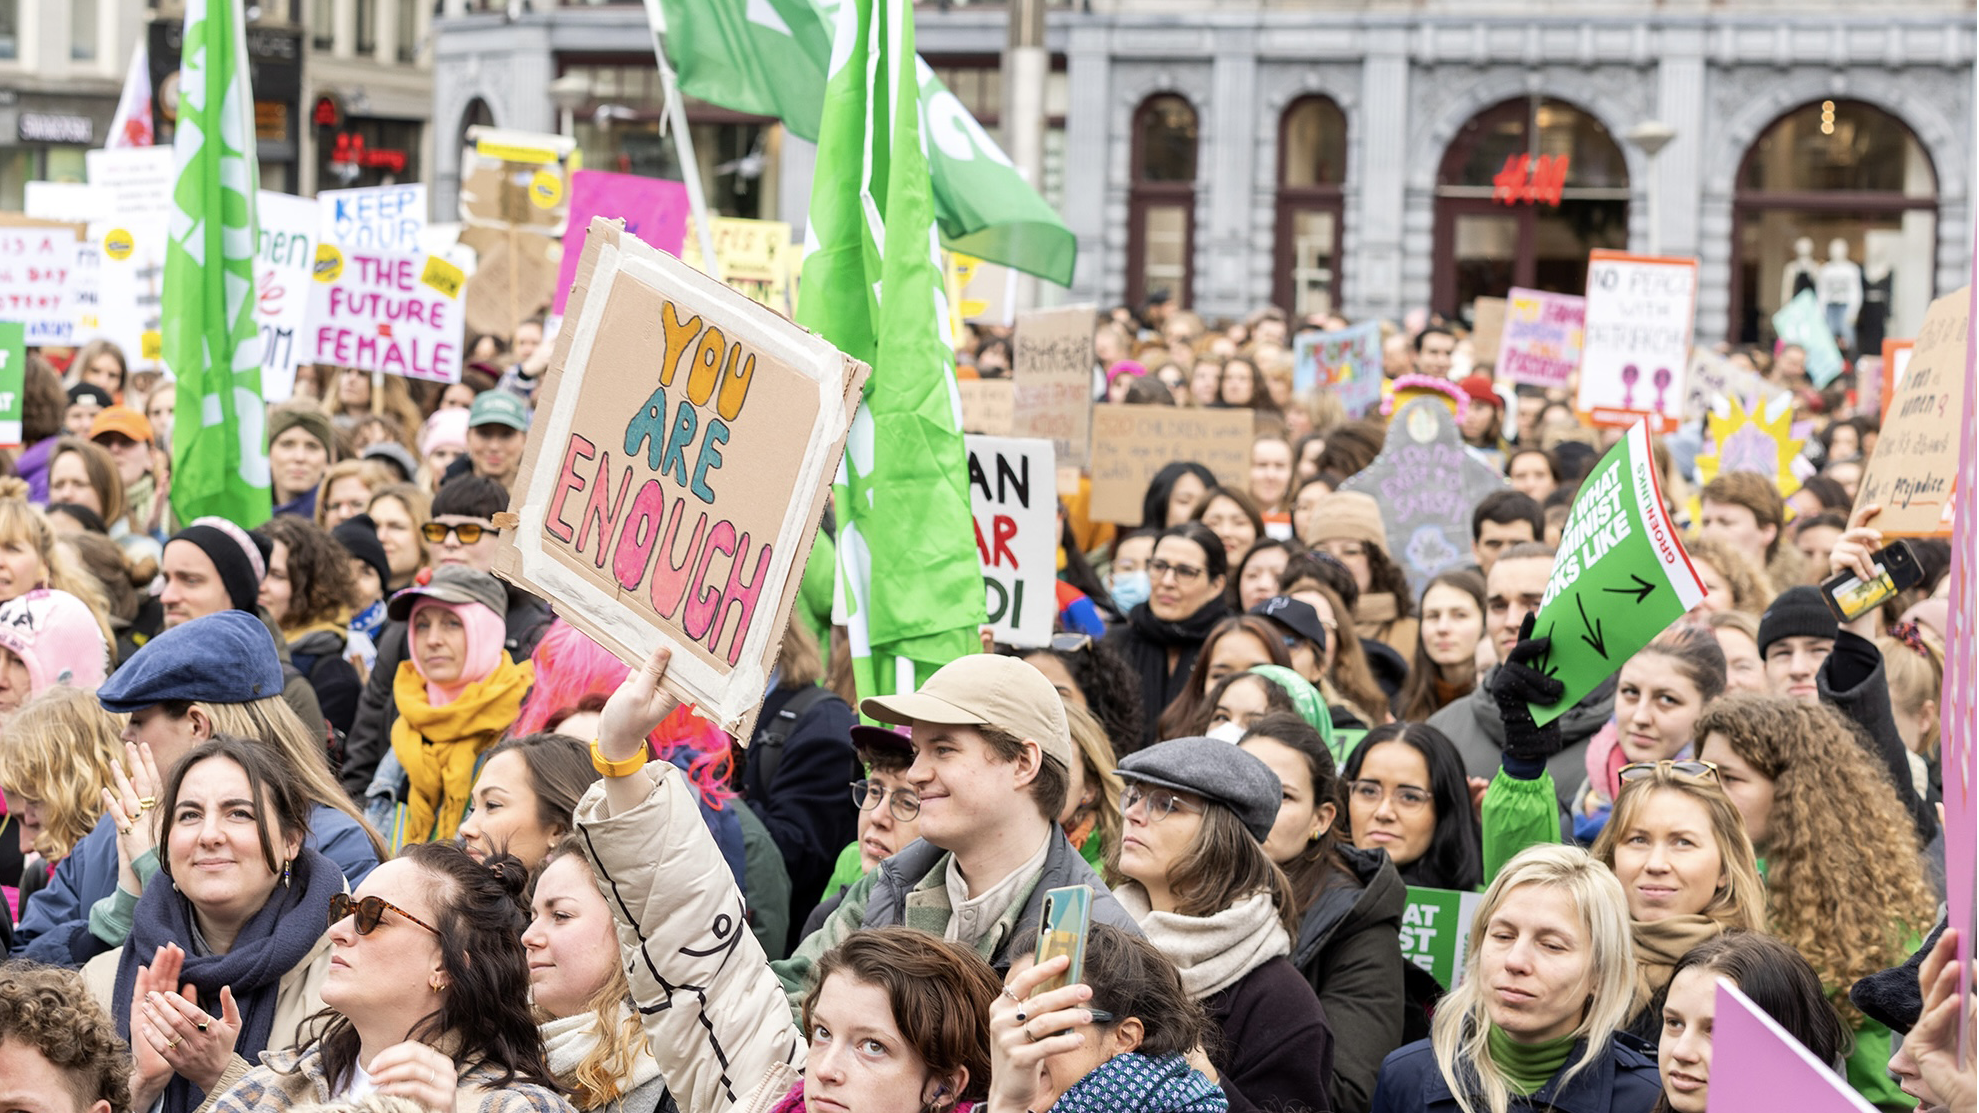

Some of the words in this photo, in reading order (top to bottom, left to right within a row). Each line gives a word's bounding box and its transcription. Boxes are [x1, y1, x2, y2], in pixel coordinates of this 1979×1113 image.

[335, 190, 416, 223] KEEP
[330, 287, 445, 329] FUTURE
[353, 255, 414, 291] THE
[318, 326, 453, 377] FEMALE
[659, 300, 756, 422] YOU
[624, 387, 730, 504] ARE
[1576, 459, 1621, 521] WHAT
[1637, 461, 1676, 565] GROENLINKS
[545, 433, 773, 668] ENOUGH
[1540, 554, 1581, 610] OKS
[1582, 509, 1632, 570] LIKE
